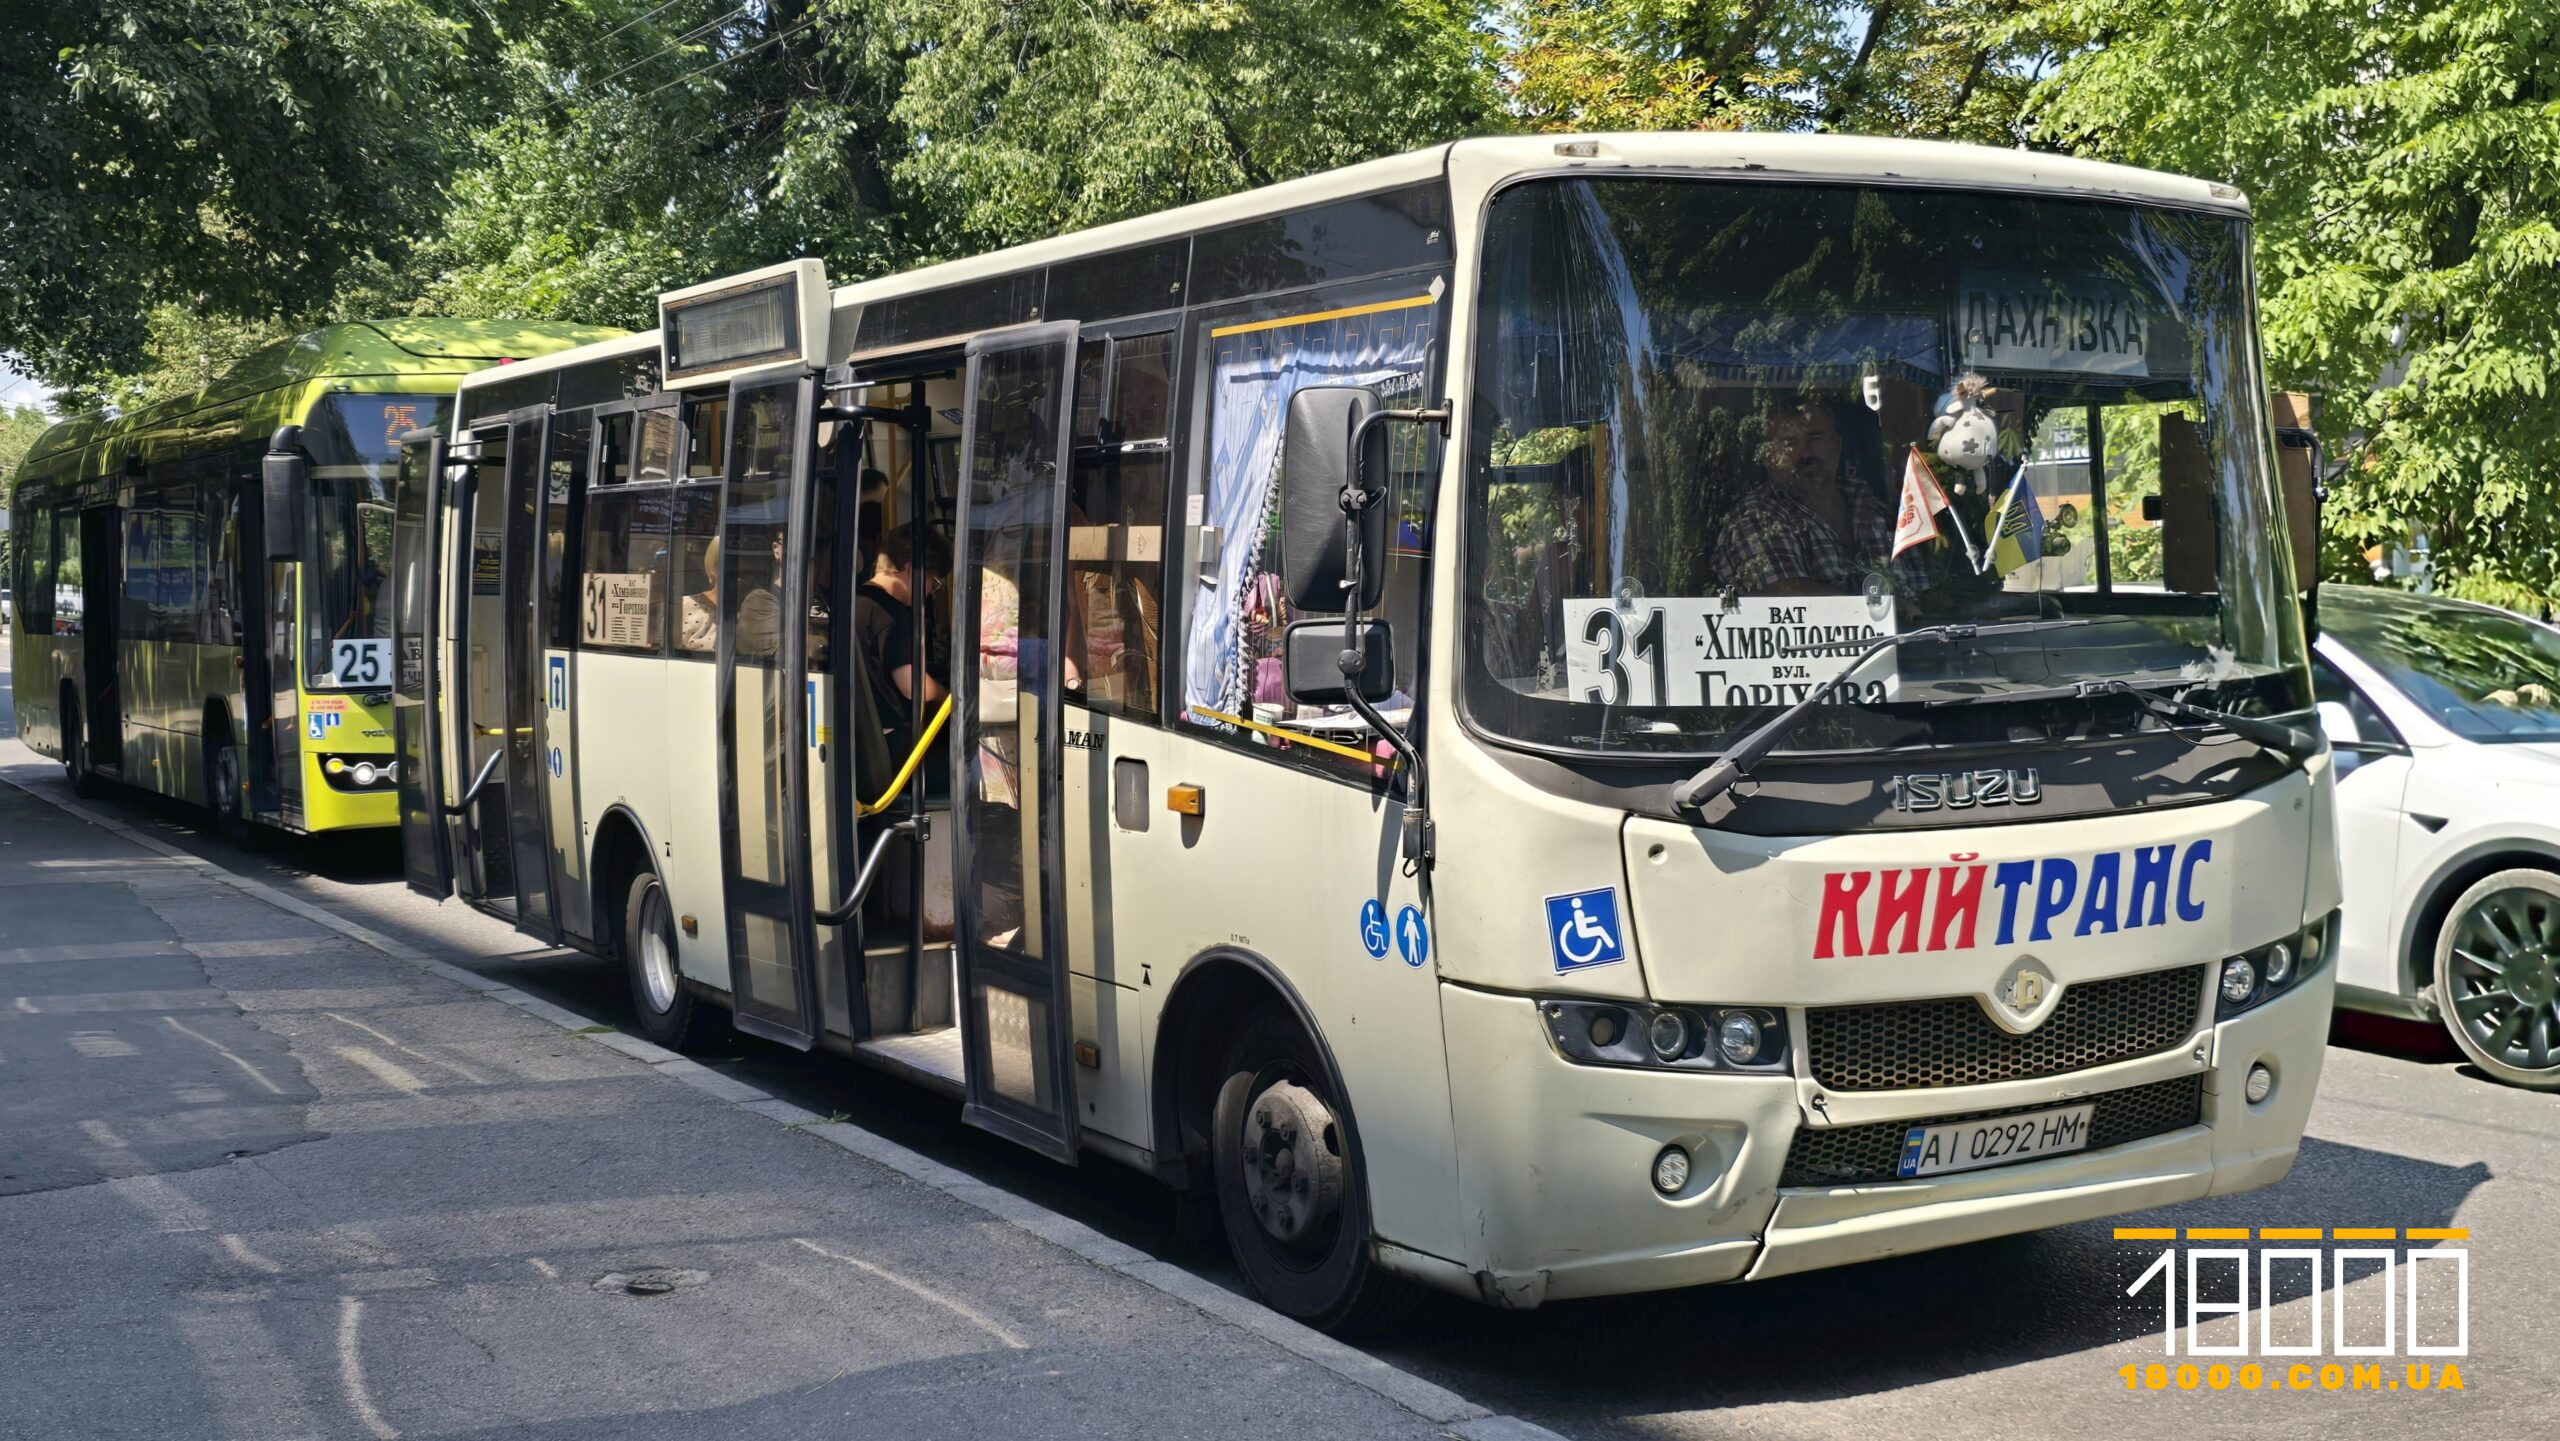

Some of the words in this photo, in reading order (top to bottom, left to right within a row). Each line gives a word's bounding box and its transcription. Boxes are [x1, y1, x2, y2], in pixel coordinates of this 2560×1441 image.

[1964, 291, 2144, 359] ДАХНІВКА
[384, 404, 417, 446] 25
[586, 579, 607, 639] 31
[1768, 606, 1807, 625] ВАТ
[338, 643, 380, 683] 25
[1581, 606, 1670, 706] 31
[1893, 767, 2042, 811] ISUZU
[1970, 1121, 2035, 1161] 0292
[1903, 1159, 1917, 1169] UA
